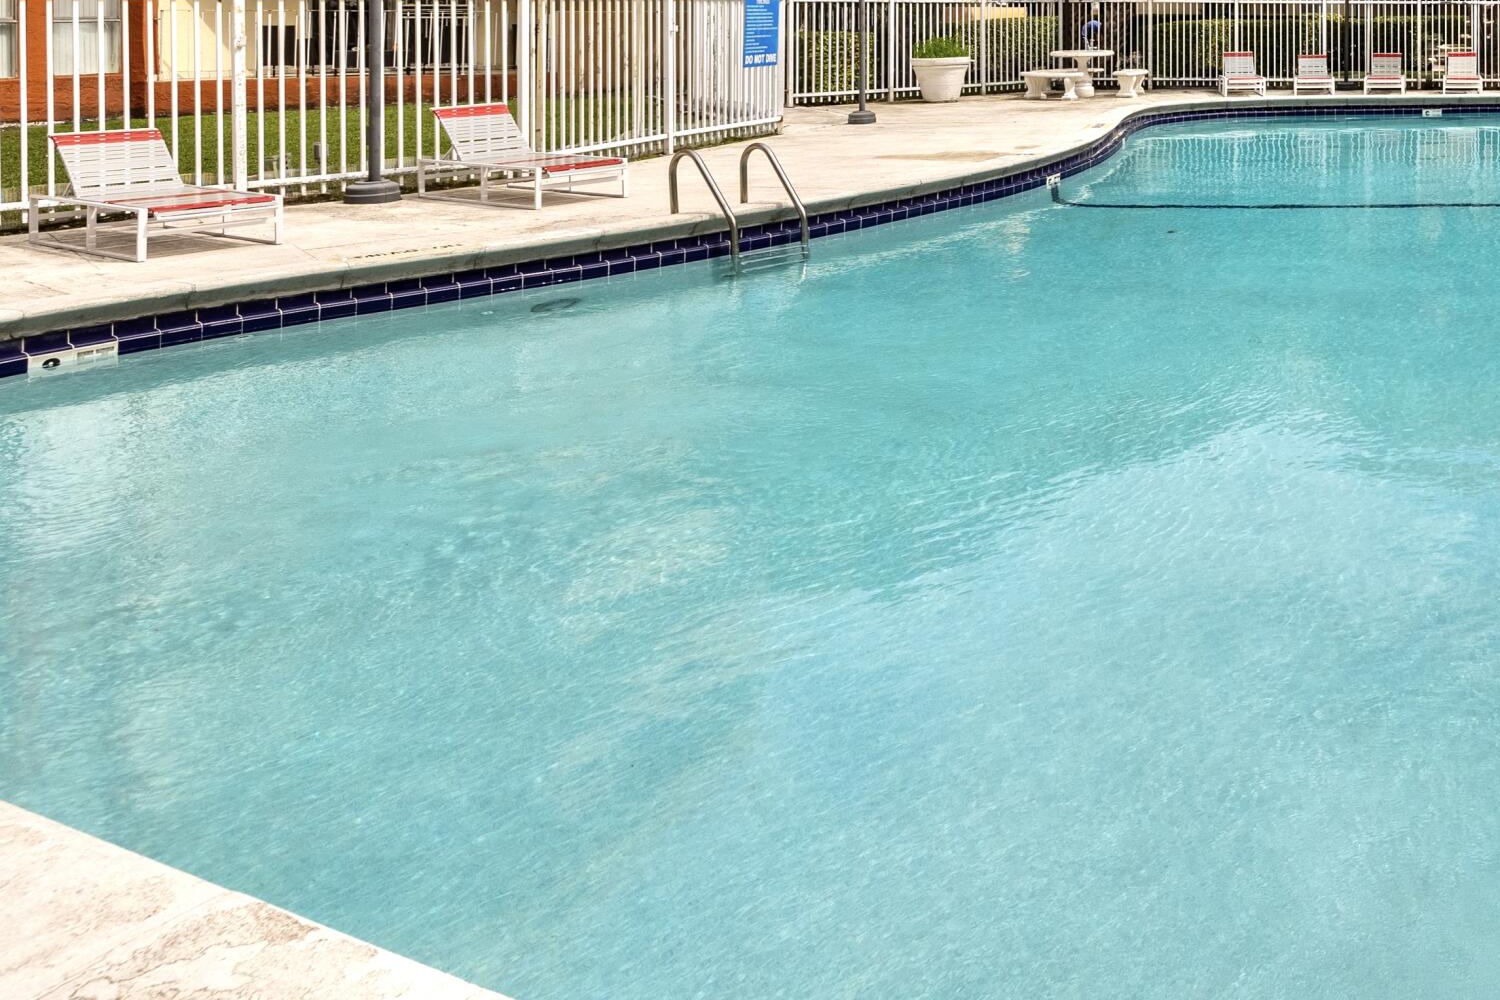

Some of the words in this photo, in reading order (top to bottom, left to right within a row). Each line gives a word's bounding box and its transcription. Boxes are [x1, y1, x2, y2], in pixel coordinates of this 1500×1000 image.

[745, 55, 753, 64] DO
[754, 54, 765, 64] NOT
[766, 53, 776, 62] DIVE
